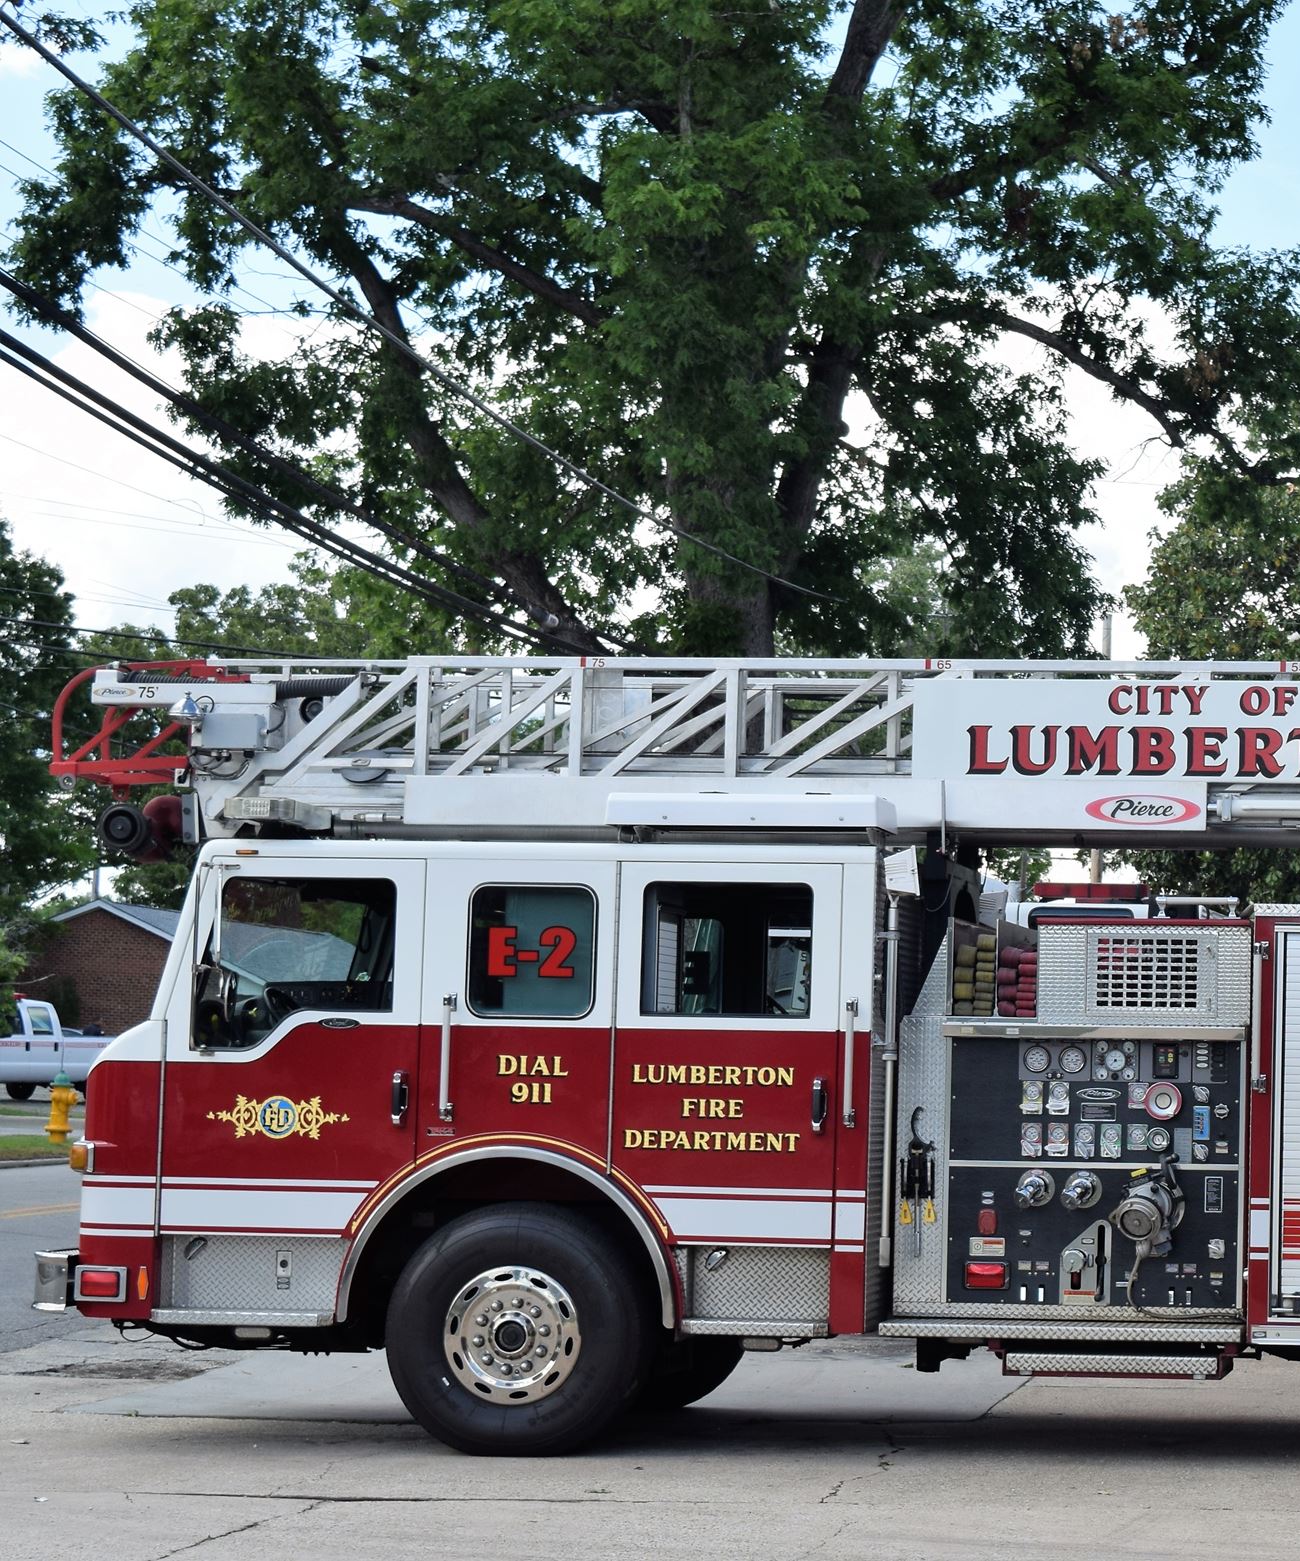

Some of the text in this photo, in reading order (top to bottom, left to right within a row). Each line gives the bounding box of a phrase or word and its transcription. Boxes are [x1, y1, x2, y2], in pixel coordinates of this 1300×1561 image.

[592, 658, 605, 667] 75
[937, 660, 951, 669] 65
[1108, 684, 1299, 717] CITY OF
[1110, 798, 1175, 819] Pierce
[487, 926, 577, 979] E-2
[497, 1055, 568, 1078] DIAL
[633, 1063, 795, 1088] LUMBERTON
[511, 1083, 552, 1105] 911
[681, 1098, 744, 1120] FIRE
[624, 1129, 801, 1154] DEPARTMENT
